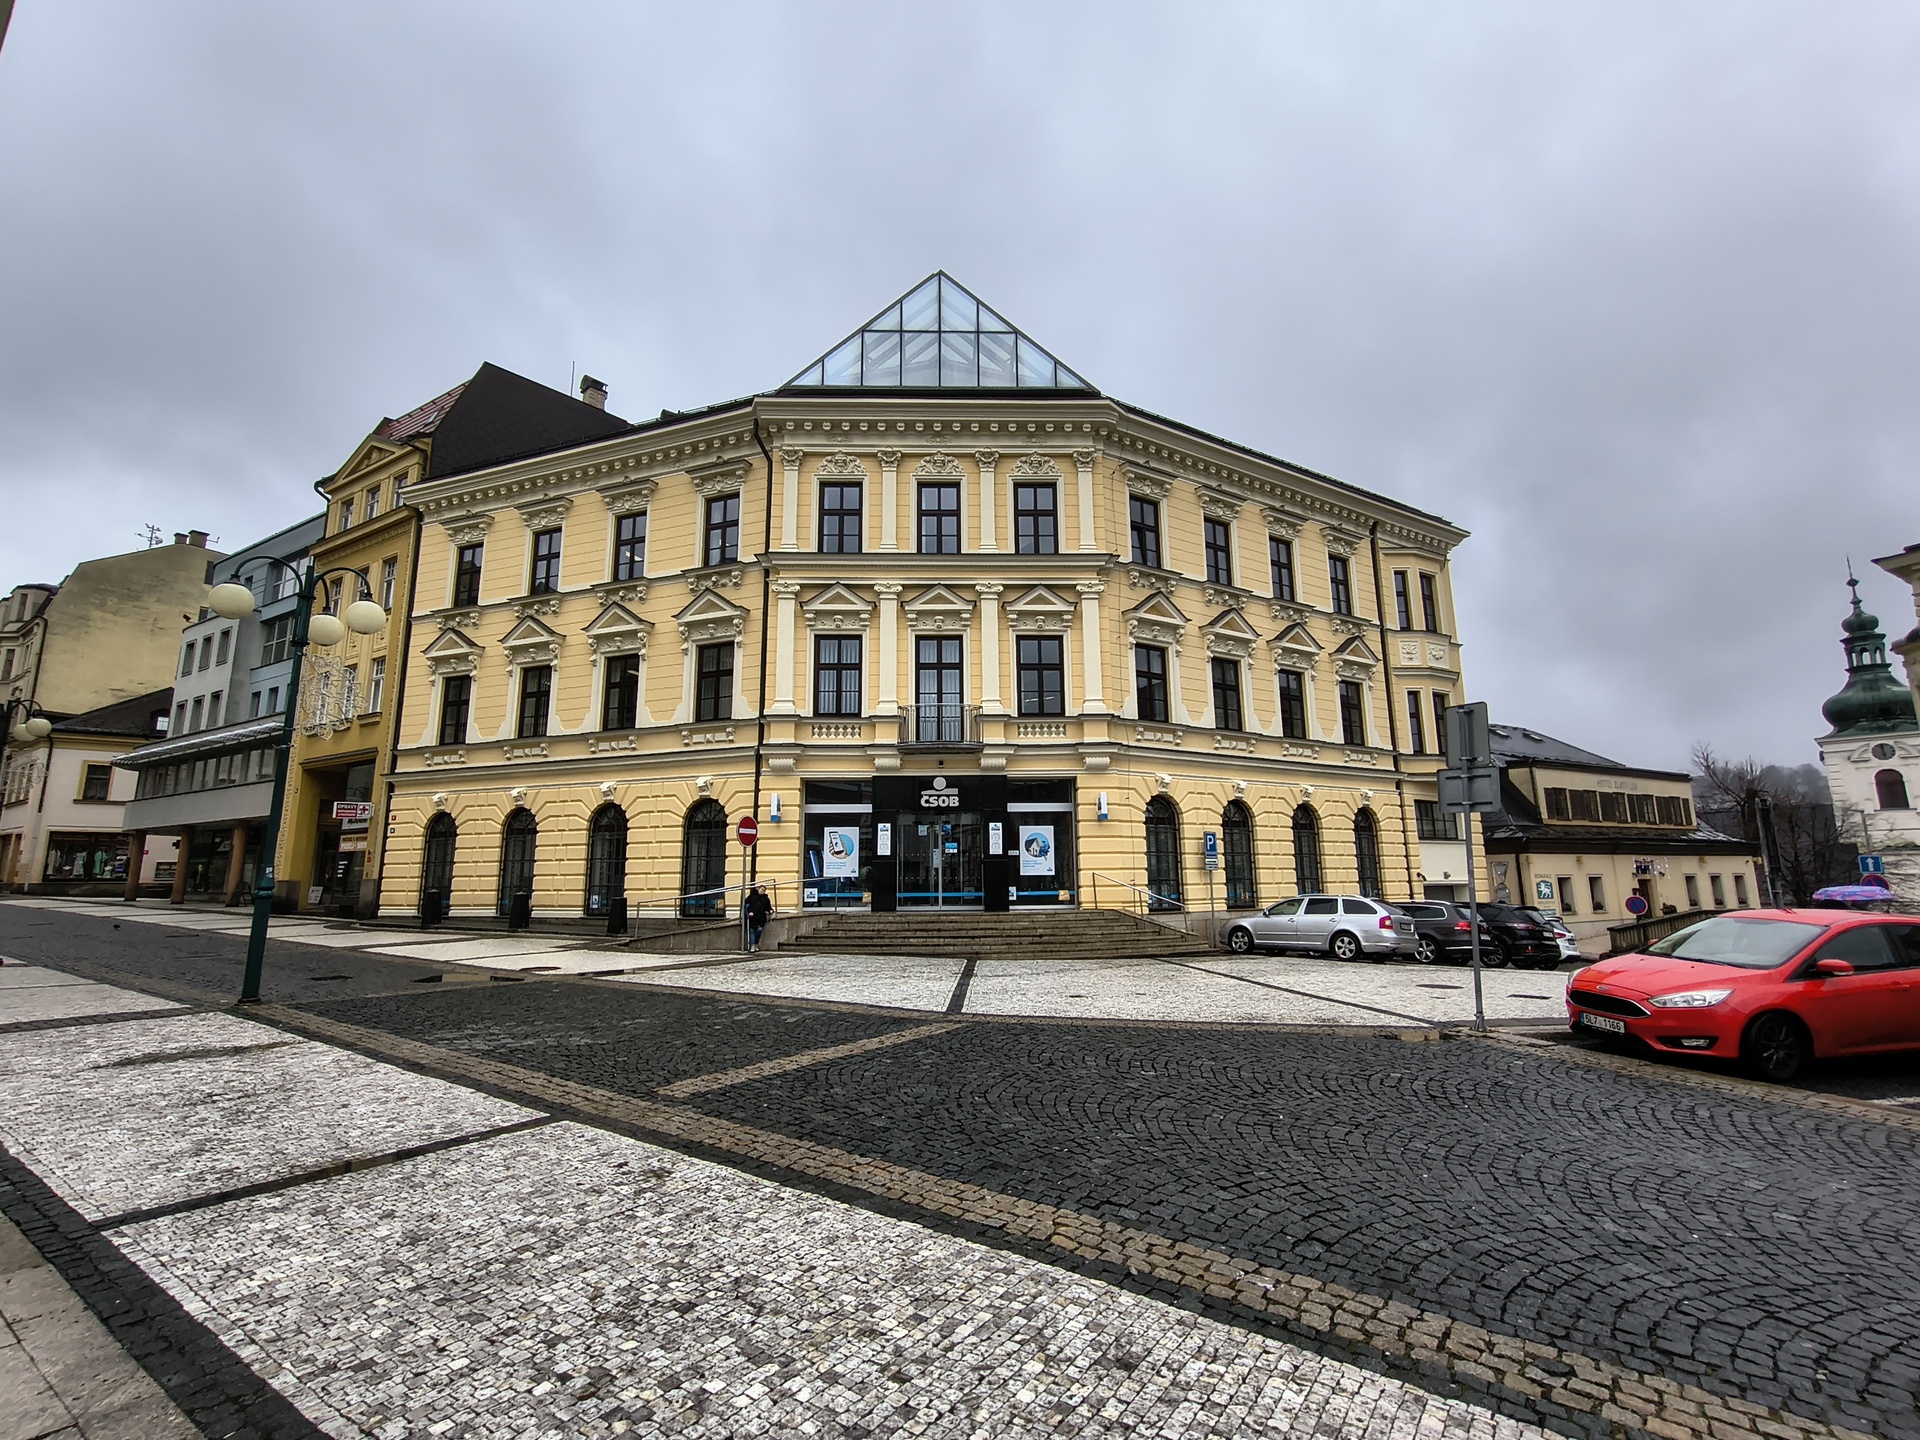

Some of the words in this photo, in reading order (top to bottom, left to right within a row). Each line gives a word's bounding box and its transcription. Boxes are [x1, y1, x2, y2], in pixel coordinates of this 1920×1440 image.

[920, 795, 959, 807] ČSOB
[1206, 835, 1214, 850] P
[1585, 1015, 1598, 1025] 5L7
[1603, 1019, 1621, 1031] 1166
